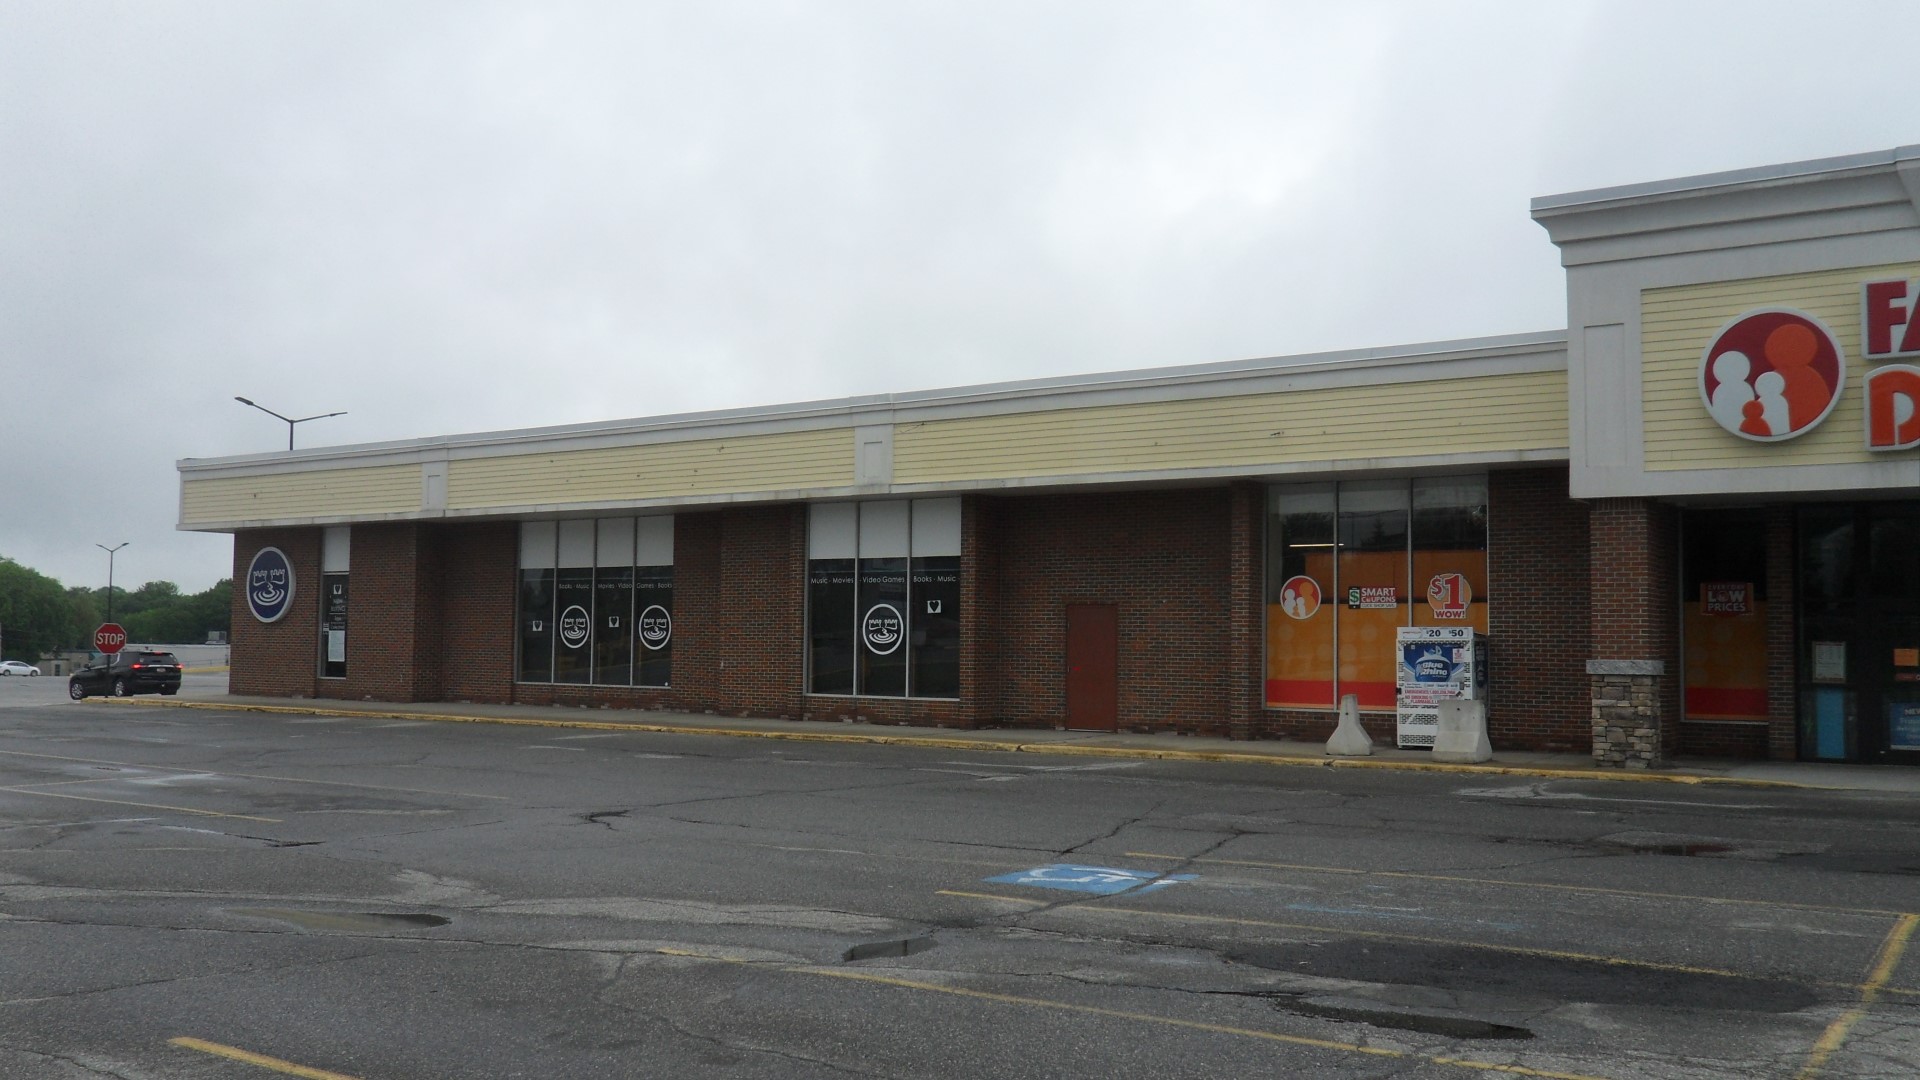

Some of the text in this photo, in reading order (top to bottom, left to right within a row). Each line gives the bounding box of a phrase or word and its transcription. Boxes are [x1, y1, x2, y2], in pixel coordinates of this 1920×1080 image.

[810, 574, 956, 585] Music Movies Video Games Books Music
[1361, 587, 1396, 597] SMART
[1430, 574, 1465, 610] $1
[1707, 590, 1745, 602] LOW
[1707, 602, 1746, 612] PRICES
[1435, 610, 1465, 618] WOW!
[1426, 629, 1464, 637] $20 $50
[96, 633, 125, 645] STOP
